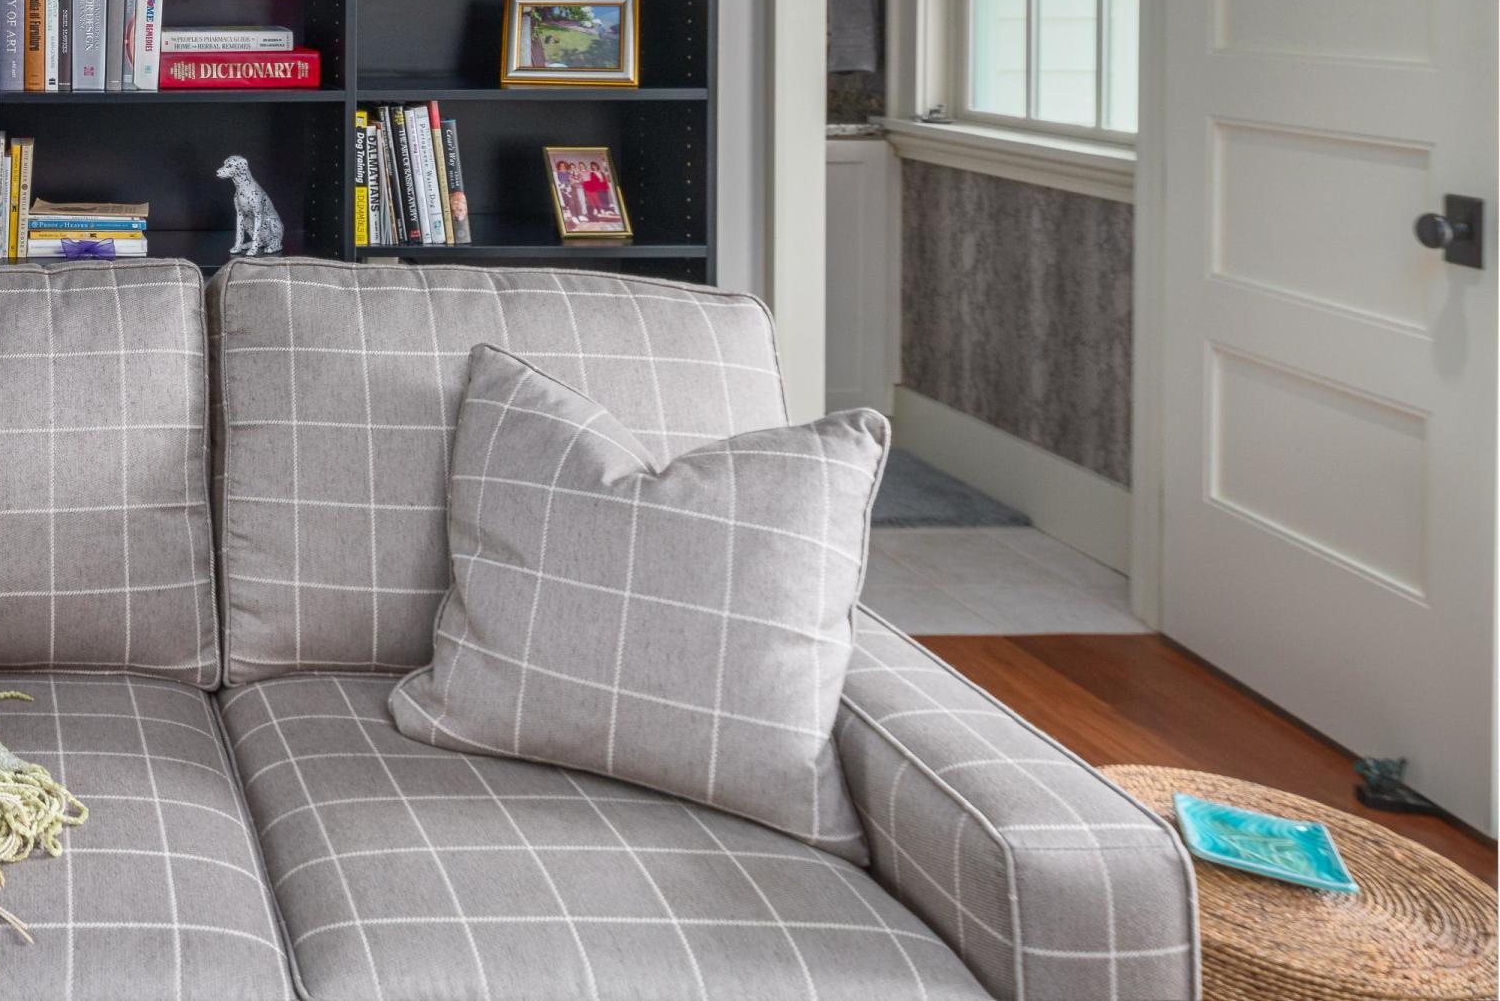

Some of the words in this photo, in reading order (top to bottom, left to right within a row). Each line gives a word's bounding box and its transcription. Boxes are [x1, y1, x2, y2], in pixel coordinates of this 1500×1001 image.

[6, 15, 17, 26] OF
[85, 14, 94, 52] DESIGN
[6, 30, 17, 54] ART
[29, 21, 41, 51] Furniture
[145, 23, 153, 52] REMEDIES
[200, 63, 295, 78] DICTIONARY
[356, 132, 364, 149] Dog
[419, 123, 430, 167] Portuguese
[446, 130, 455, 151] Cesar's
[356, 150, 365, 183] Training
[448, 152, 456, 167] Way
[367, 135, 380, 212] DALMATIANS
